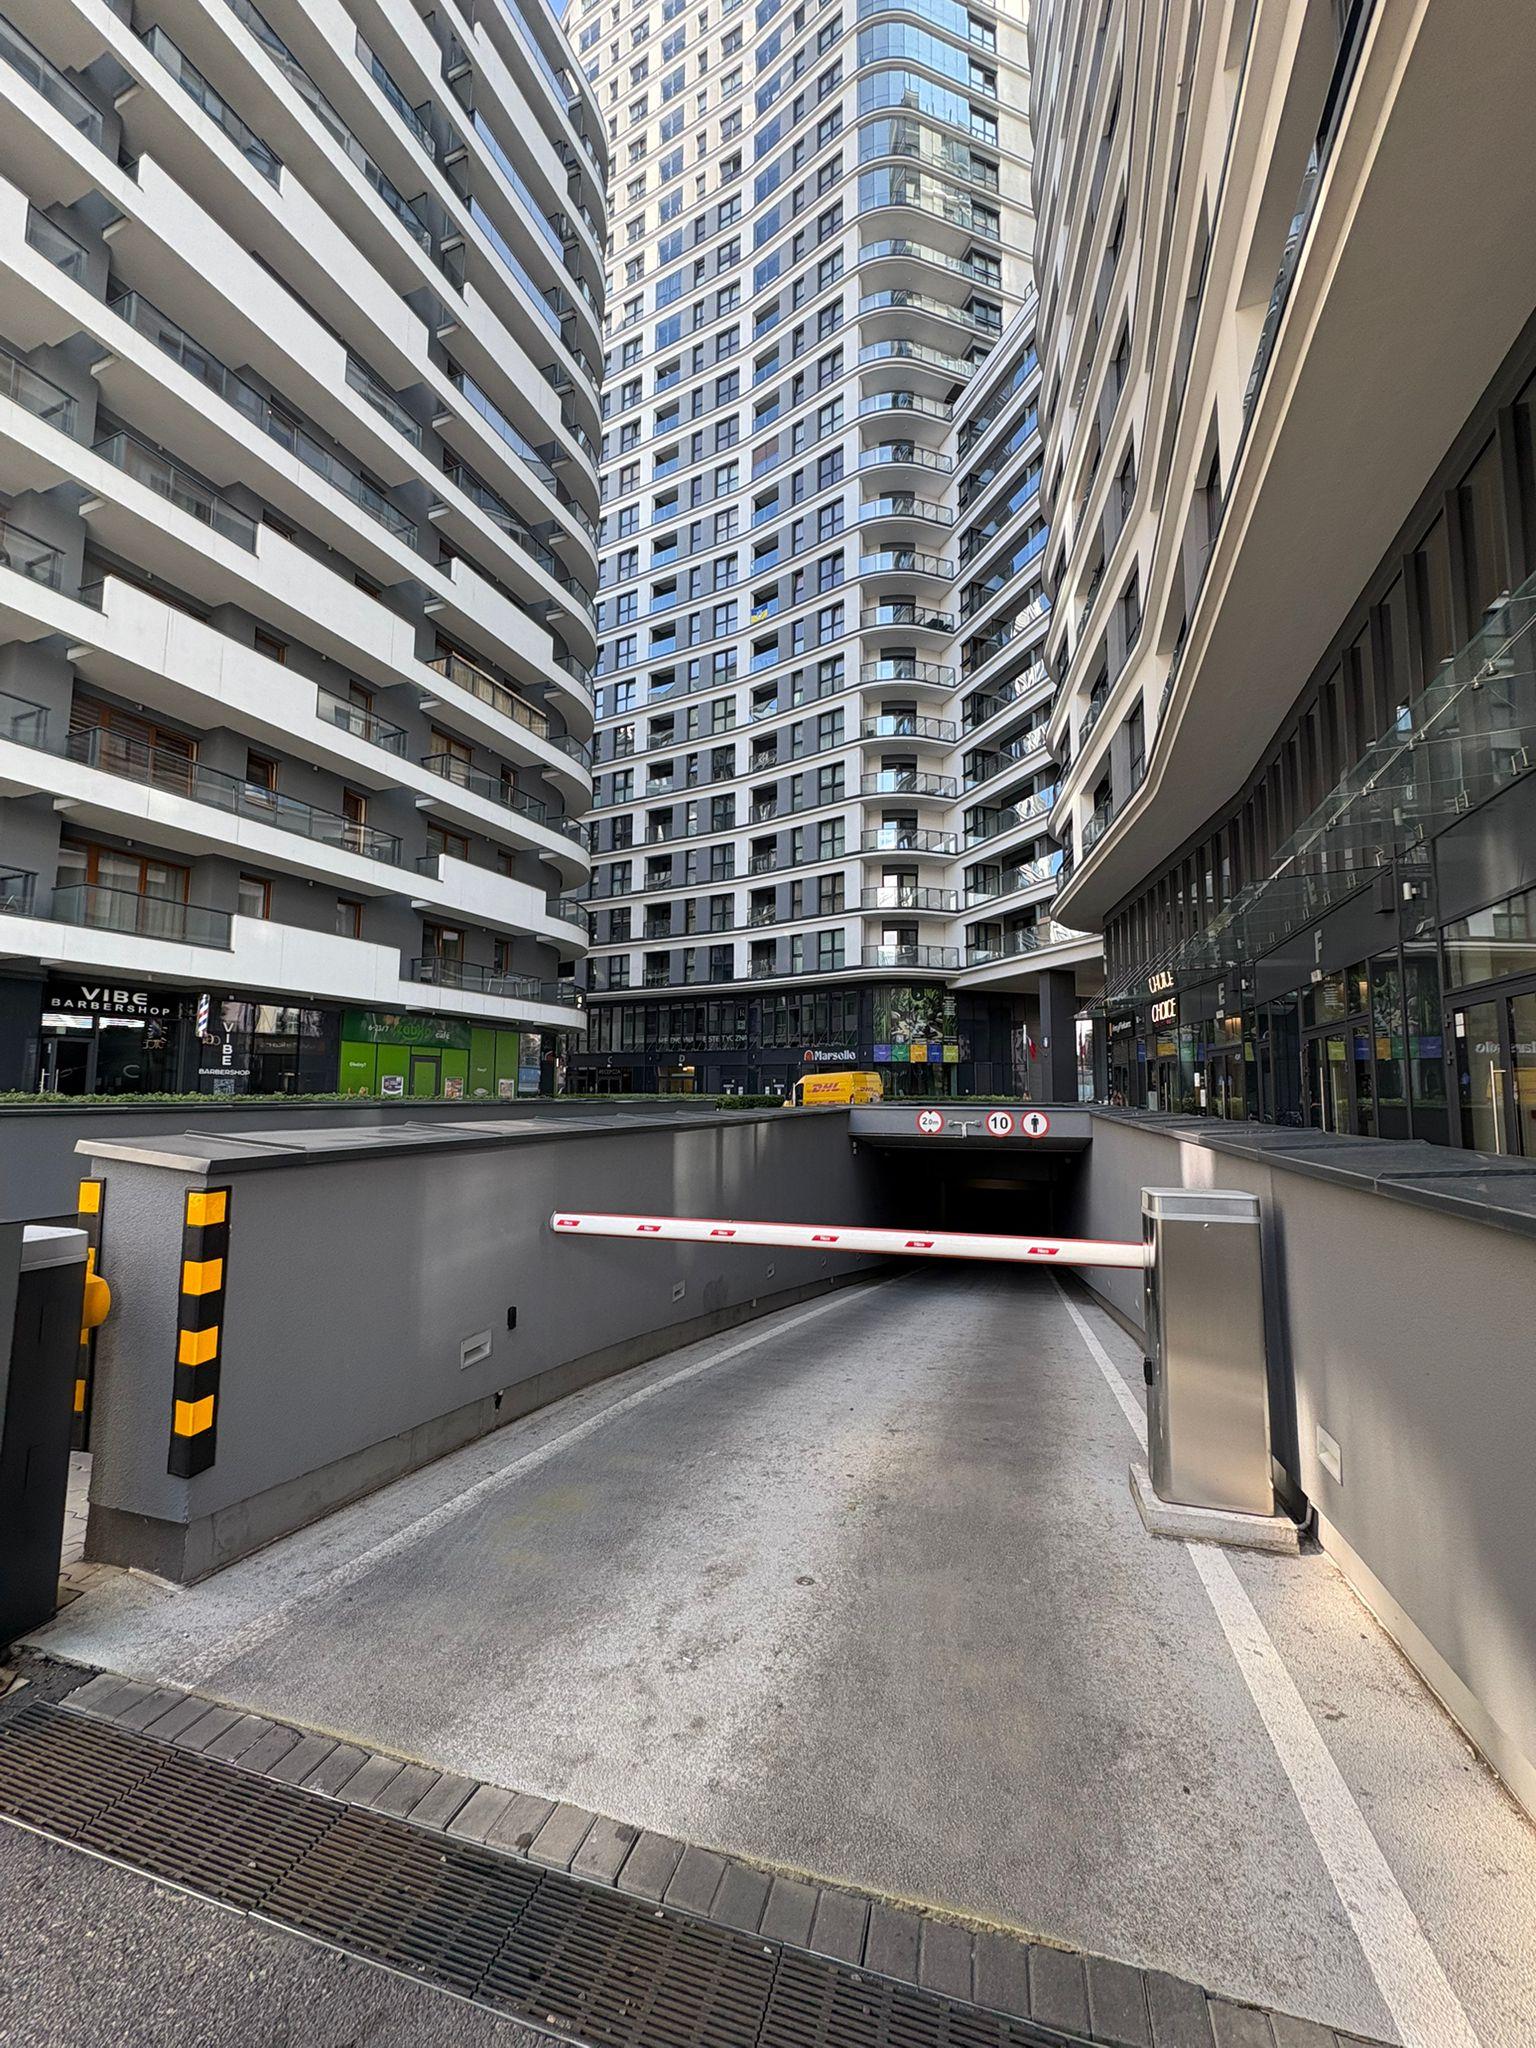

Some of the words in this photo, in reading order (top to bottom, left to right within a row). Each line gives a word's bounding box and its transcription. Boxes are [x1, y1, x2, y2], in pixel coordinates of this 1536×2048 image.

[1314, 929, 1323, 964] F
[81, 986, 148, 1006] VIBE
[1217, 982, 1226, 1006] E
[51, 998, 170, 1016] BARBERSHOP
[1151, 997, 1177, 1023] CHOICE
[222, 1022, 235, 1066] VIBE
[679, 1055, 686, 1063] D
[198, 1067, 251, 1077] BARBERSHOP
[812, 1082, 841, 1093] DHL
[990, 1116, 1009, 1130] 10
